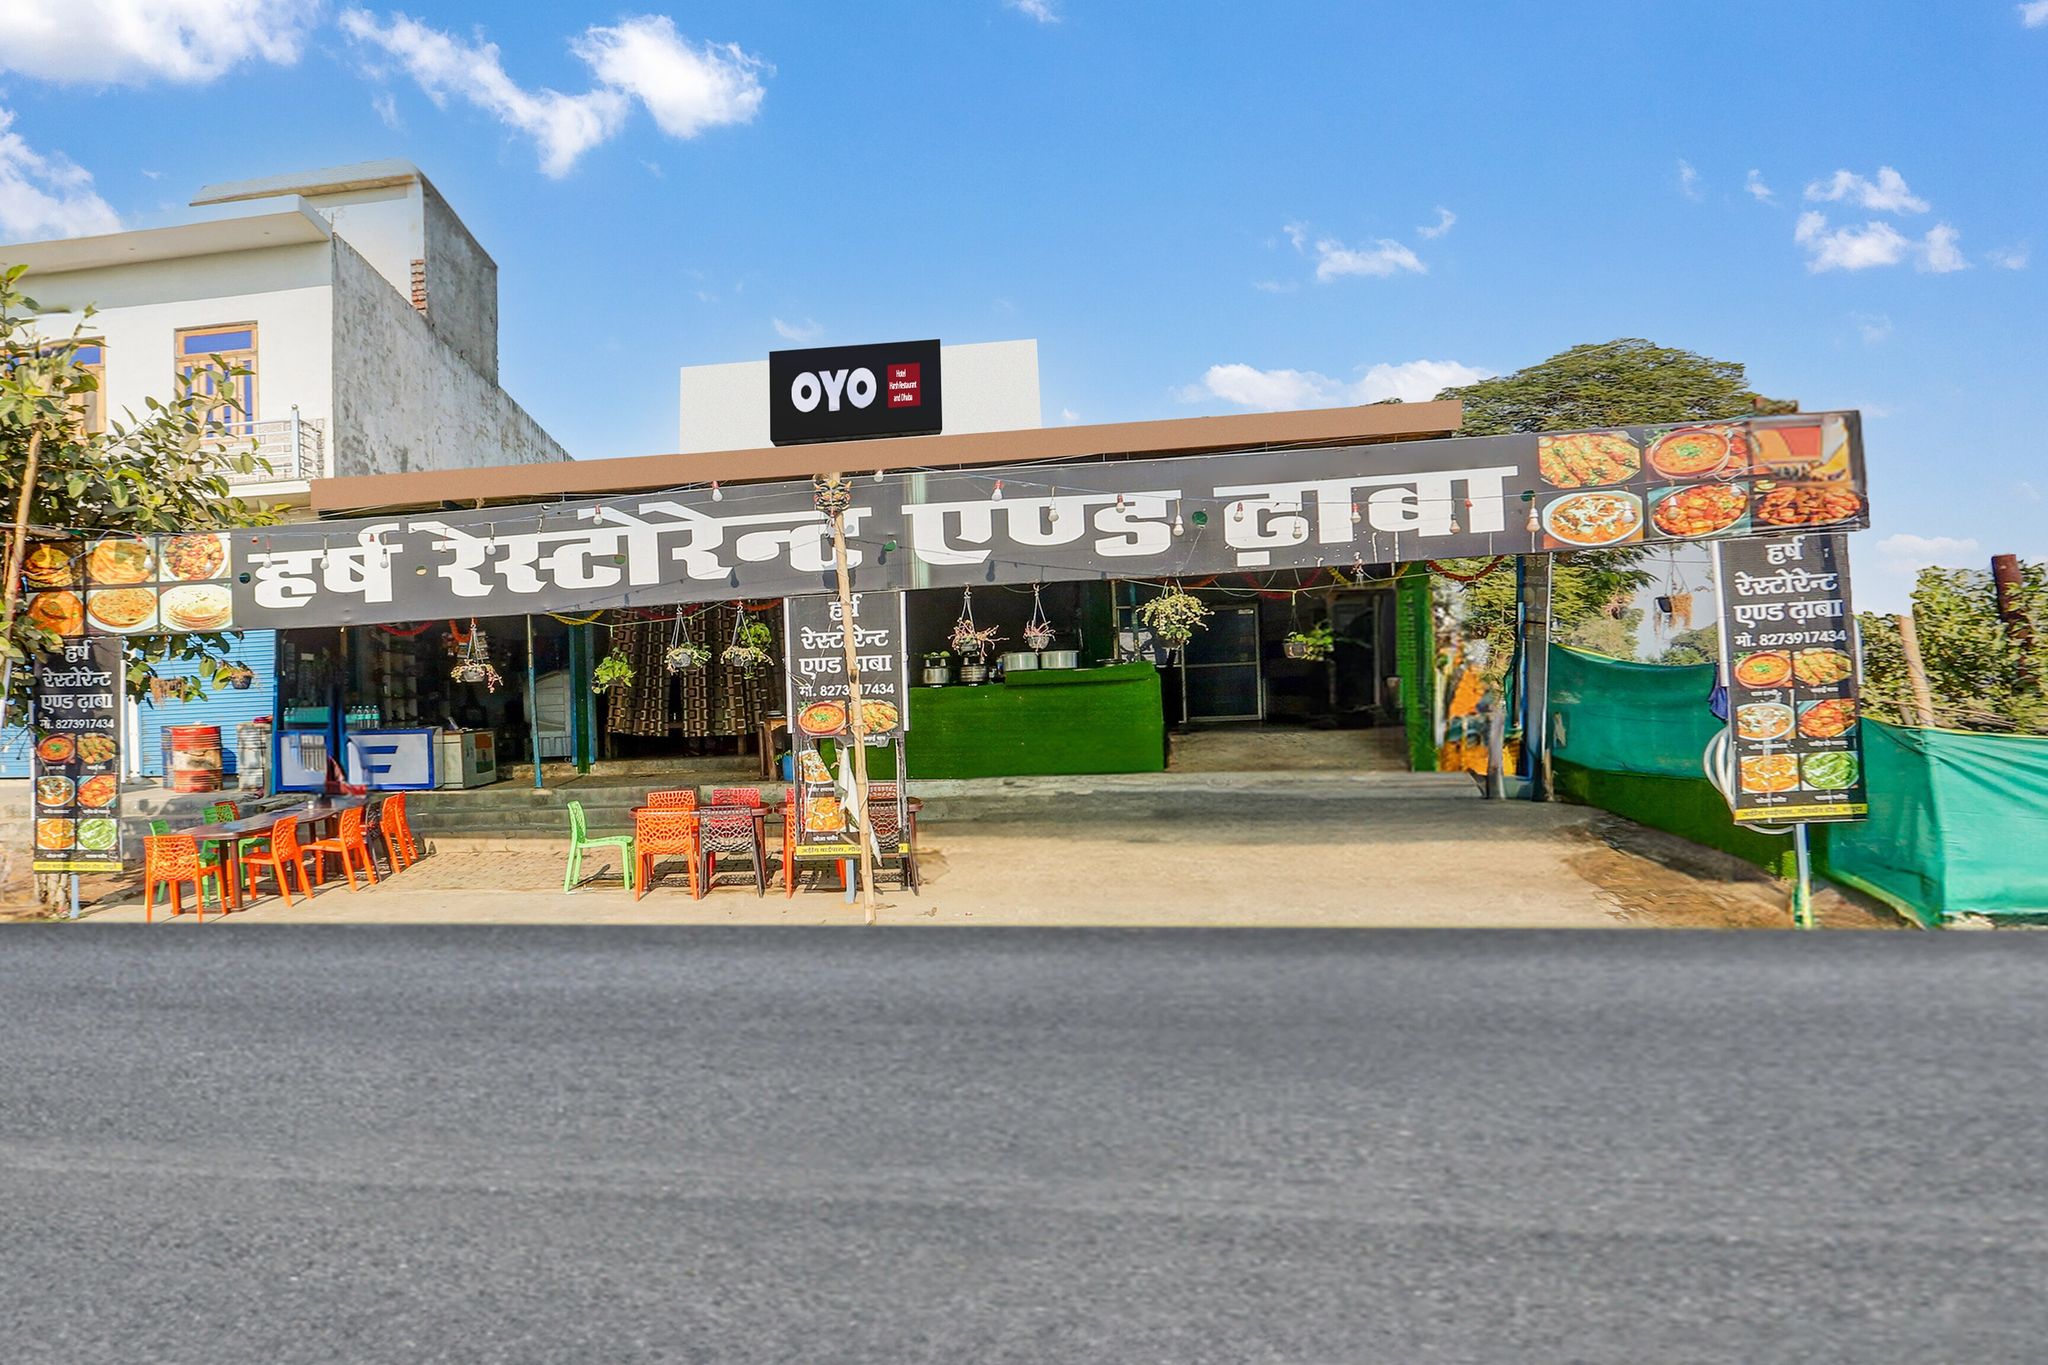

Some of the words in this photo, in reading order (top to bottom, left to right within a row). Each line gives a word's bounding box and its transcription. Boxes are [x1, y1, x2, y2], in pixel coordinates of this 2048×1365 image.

[895, 369, 907, 378] Hotel
[791, 367, 877, 413] OYO
[247, 523, 403, 609] हर्ष
[901, 489, 1182, 565] एण्ड
[1765, 536, 1806, 565] हर्ष
[1733, 603, 1785, 629] एण्ड
[1759, 630, 1847, 646] 8273917434
[64, 640, 92, 663] हर्ष
[798, 657, 842, 680] एण्ड
[820, 683, 895, 697] 827317434
[39, 694, 74, 714] एण्ड
[55, 719, 115, 729] 8273917434
